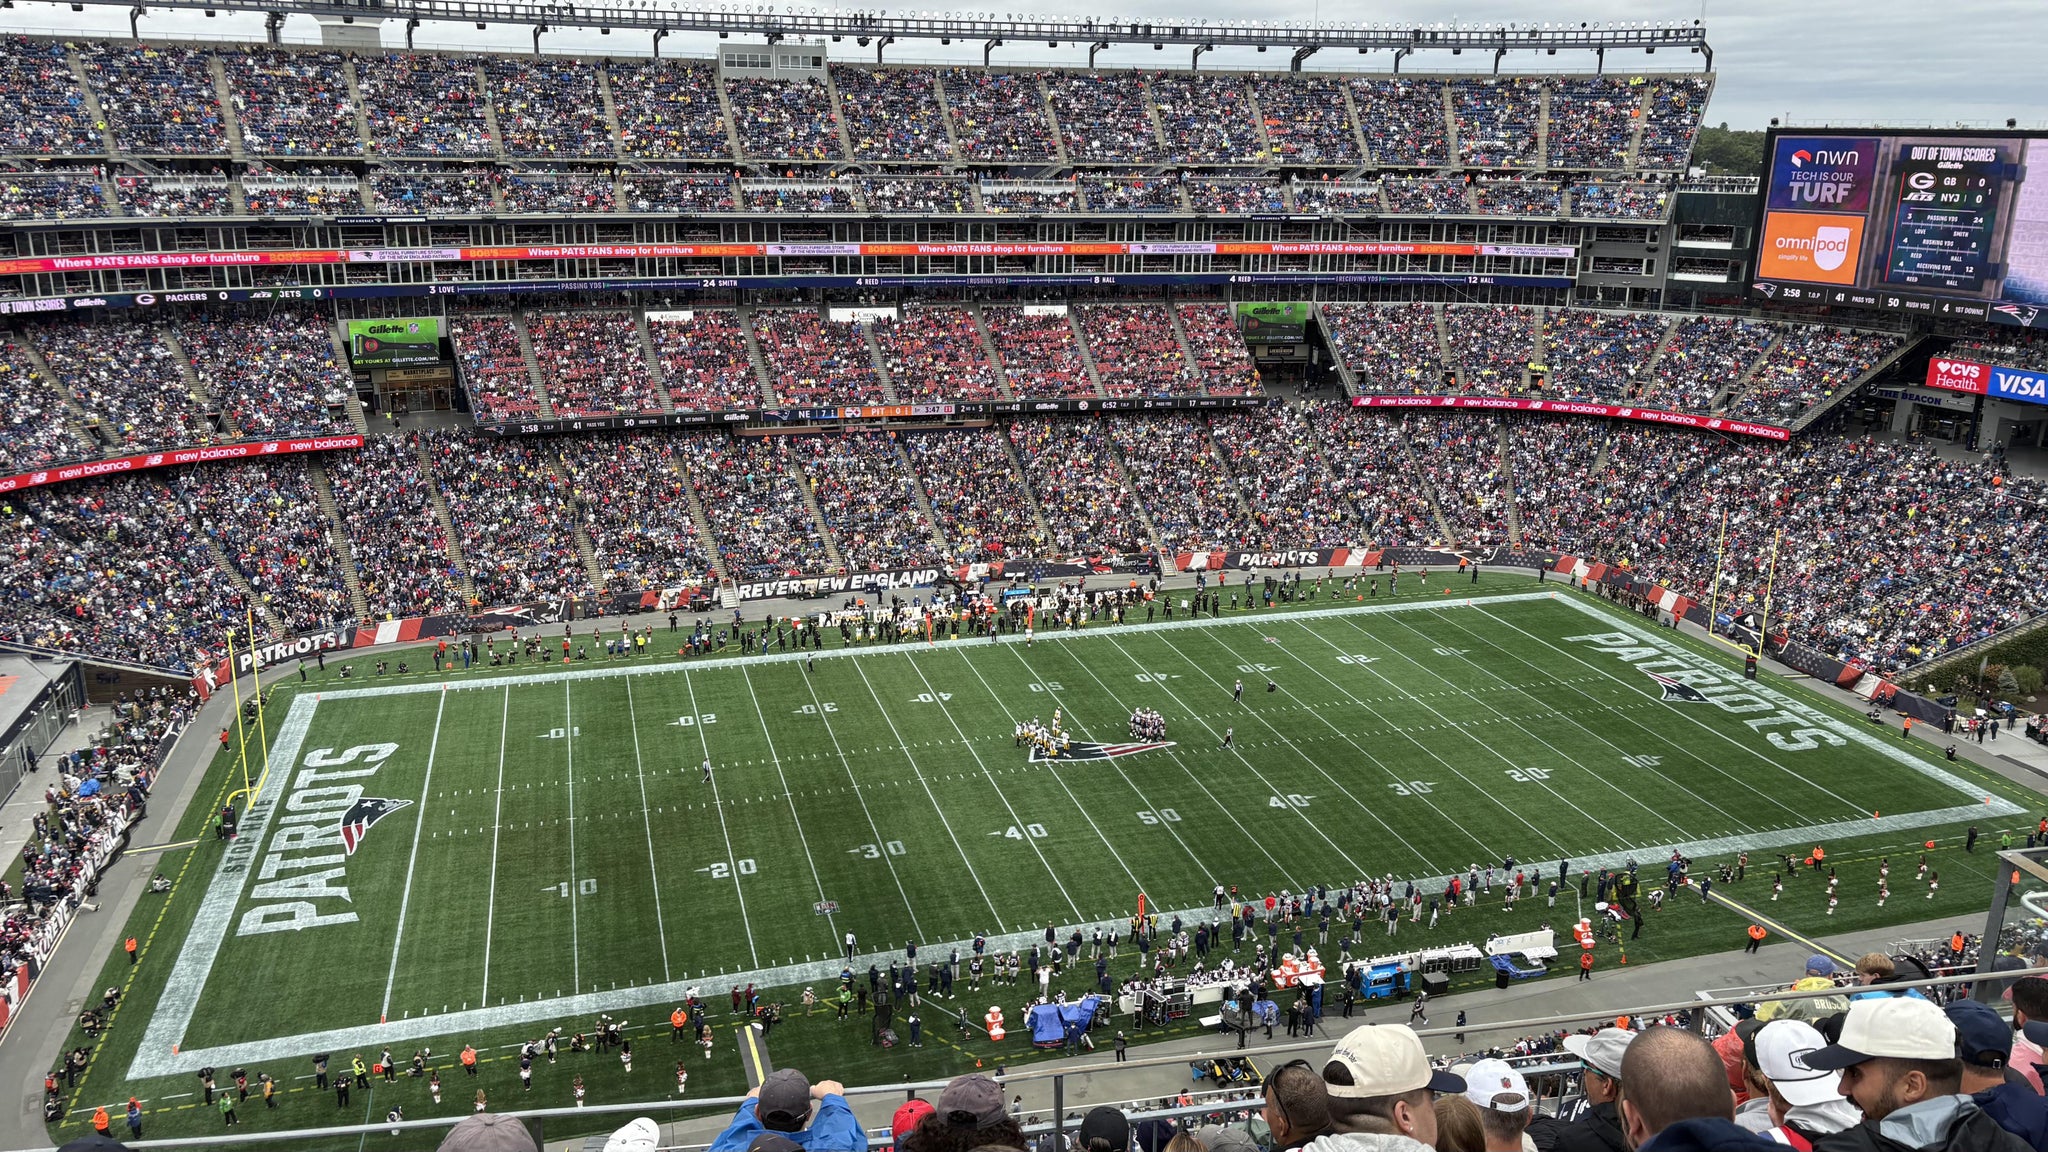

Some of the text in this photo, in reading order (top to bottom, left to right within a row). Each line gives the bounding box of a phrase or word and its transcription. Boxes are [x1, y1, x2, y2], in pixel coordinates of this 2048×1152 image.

[1816, 151, 1858, 165] nwn
[1911, 146, 1995, 162] OUT OF TOWN SCORES
[1791, 171, 1854, 182] TECH IS OUR
[1943, 178, 1985, 187] GB 0
[1789, 182, 1852, 203] TURF
[1941, 193, 1982, 204] NYJ 0
[994, 246, 1012, 254] shop
[1345, 245, 1363, 253] shop
[1378, 244, 1414, 252] furniture
[1775, 236, 1847, 252] omnipod
[469, 249, 498, 257] BOB'S
[528, 246, 693, 257] Where PATS FANS shop for furniture
[53, 258, 92, 269] Where
[95, 257, 124, 266] PATS
[127, 255, 159, 265] FANS
[161, 255, 189, 265] shop
[191, 254, 208, 263] for
[210, 253, 260, 263] furniture
[165, 293, 207, 301] PACKERS
[219, 291, 228, 300] 0
[313, 289, 322, 297] 0
[1783, 288, 1801, 297] 3:58
[1835, 293, 1845, 302] 41
[1888, 298, 1899, 307] 50
[1943, 304, 1949, 312] 4
[1964, 307, 1984, 316] DOWNS
[0, 299, 66, 313] OF TOWN SCORES
[369, 325, 404, 334] Gillette
[1951, 363, 1980, 378] CVS
[1996, 373, 2045, 398] VISA
[1880, 390, 1942, 405] THE BEACON
[1102, 401, 1117, 409] 6:52
[1483, 399, 1518, 407] balance
[1571, 404, 1607, 414] balance
[1660, 412, 1696, 424] balance
[1730, 423, 1748, 432] new
[1749, 424, 1784, 438] balance
[59, 437, 358, 479] new balance new balance new balance
[1238, 550, 1318, 567] PATRIOTS
[1336, 654, 1373, 664] 20
[1237, 663, 1272, 673] 30
[1135, 672, 1167, 683] 40
[1029, 682, 1064, 693] 50
[1562, 632, 1848, 751] PATRIOTS
[917, 691, 953, 703] 40
[801, 702, 839, 715] 30
[679, 713, 717, 726] 20
[1804, 710, 1836, 724] US
[550, 726, 581, 739] 10
[1622, 754, 1661, 767] 10
[1505, 767, 1550, 782] 20
[1387, 780, 1433, 796] 30
[1268, 793, 1312, 810] 40
[1136, 808, 1182, 825] 50
[223, 800, 272, 874] STOP HATE
[1004, 823, 1048, 840] 40
[236, 742, 400, 936] PATRIOTS
[860, 840, 906, 859] 30
[710, 859, 757, 879] 20
[559, 878, 597, 897] 10
